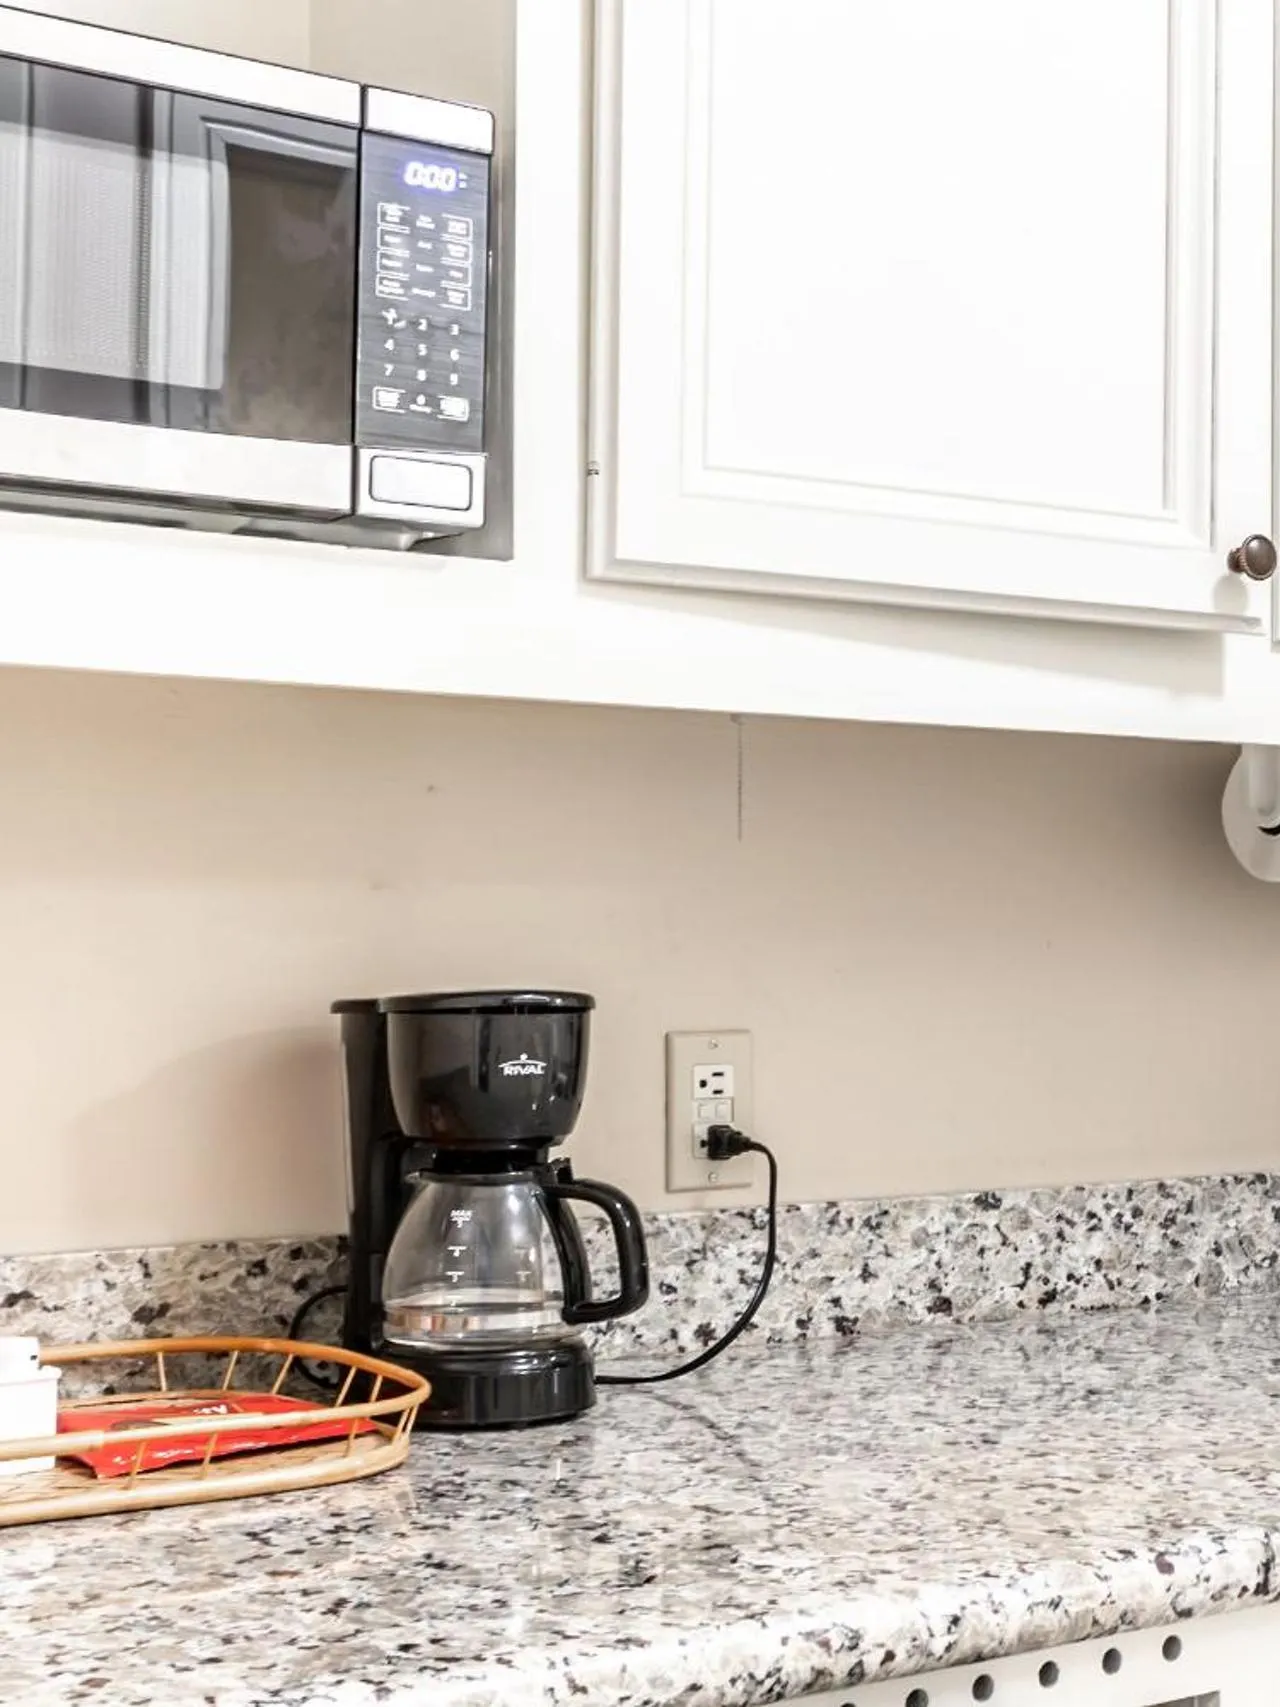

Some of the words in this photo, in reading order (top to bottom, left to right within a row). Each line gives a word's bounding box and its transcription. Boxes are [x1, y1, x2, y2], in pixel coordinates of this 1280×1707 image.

[418, 319, 428, 331] 2
[384, 339, 395, 351] 4
[418, 344, 428, 356] 5
[450, 349, 460, 361] 6
[384, 363, 394, 376] 7
[503, 1065, 545, 1076] RIVAL
